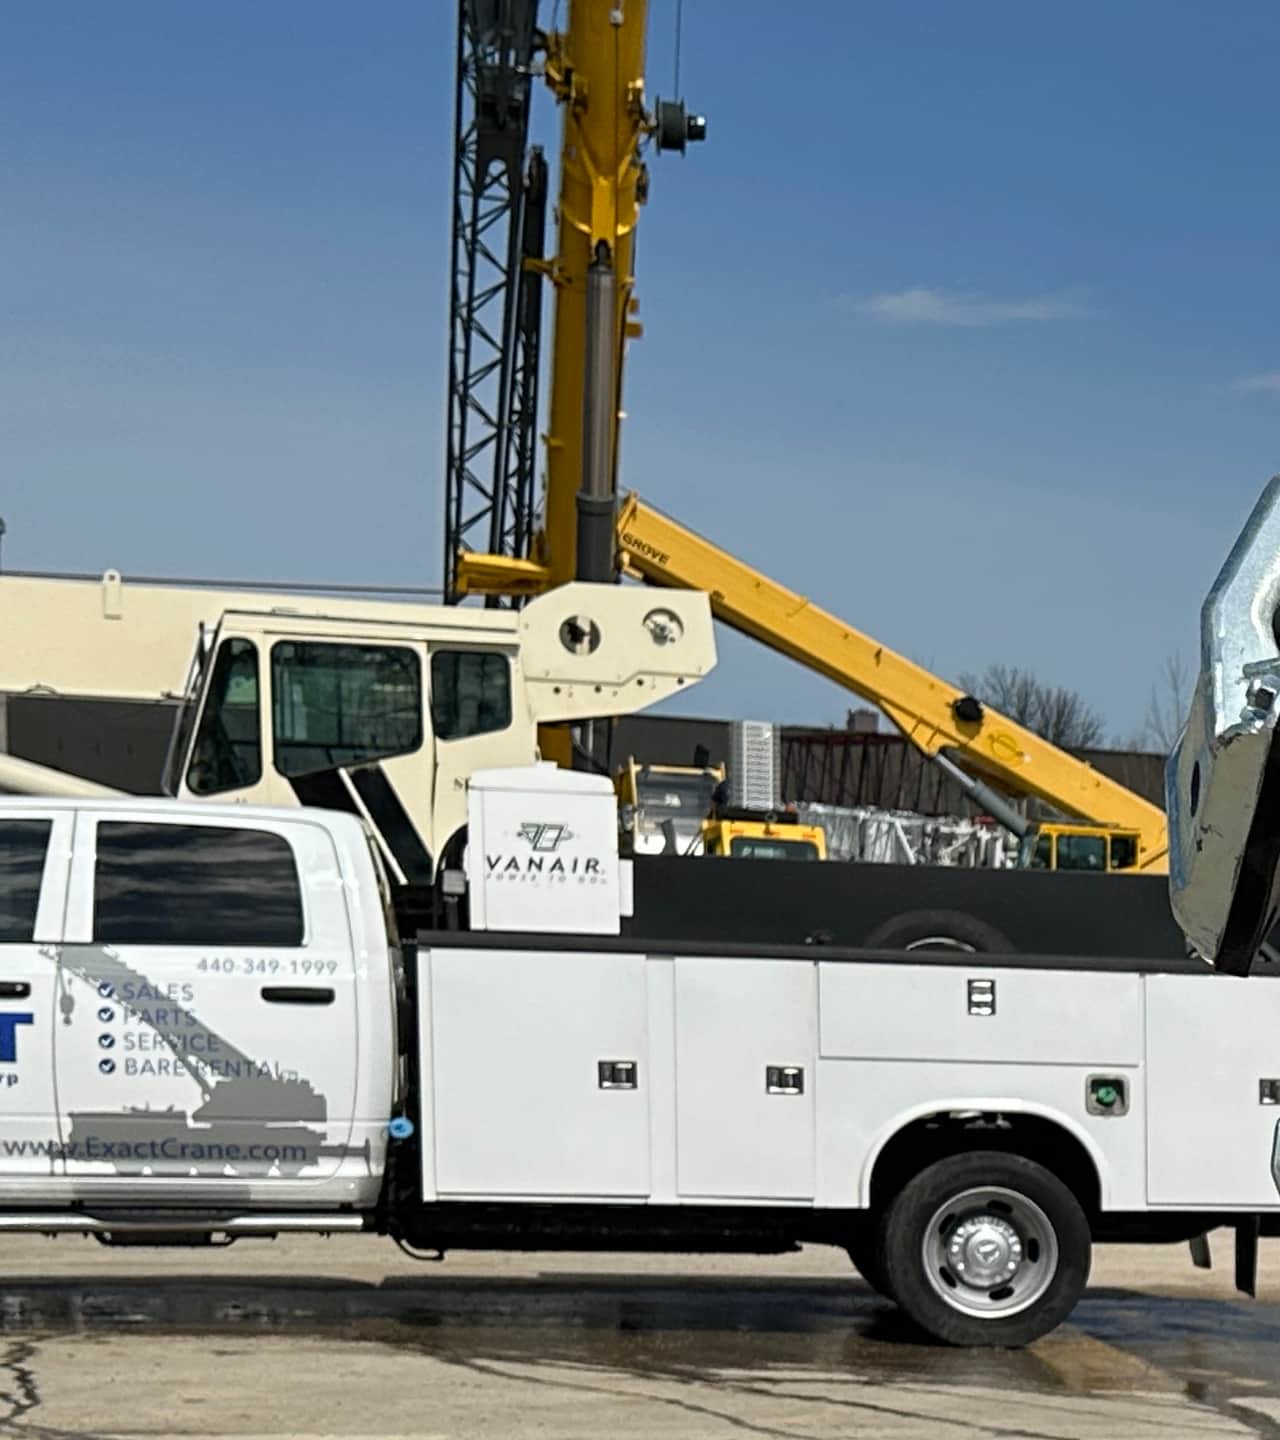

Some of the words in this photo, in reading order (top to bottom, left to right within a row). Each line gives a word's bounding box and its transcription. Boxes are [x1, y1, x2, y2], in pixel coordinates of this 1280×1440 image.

[622, 533, 671, 565] GROVE
[486, 855, 600, 874] VANAIR
[197, 957, 338, 976] 440-349-1999
[122, 983, 194, 1001] SALES
[123, 1007, 197, 1026] PARTS
[123, 1031, 219, 1052] SERVICE
[124, 1058, 186, 1076] BARE
[198, 1059, 282, 1080] RENTAL
[2, 1136, 307, 1161] www.ExactCrane.com
